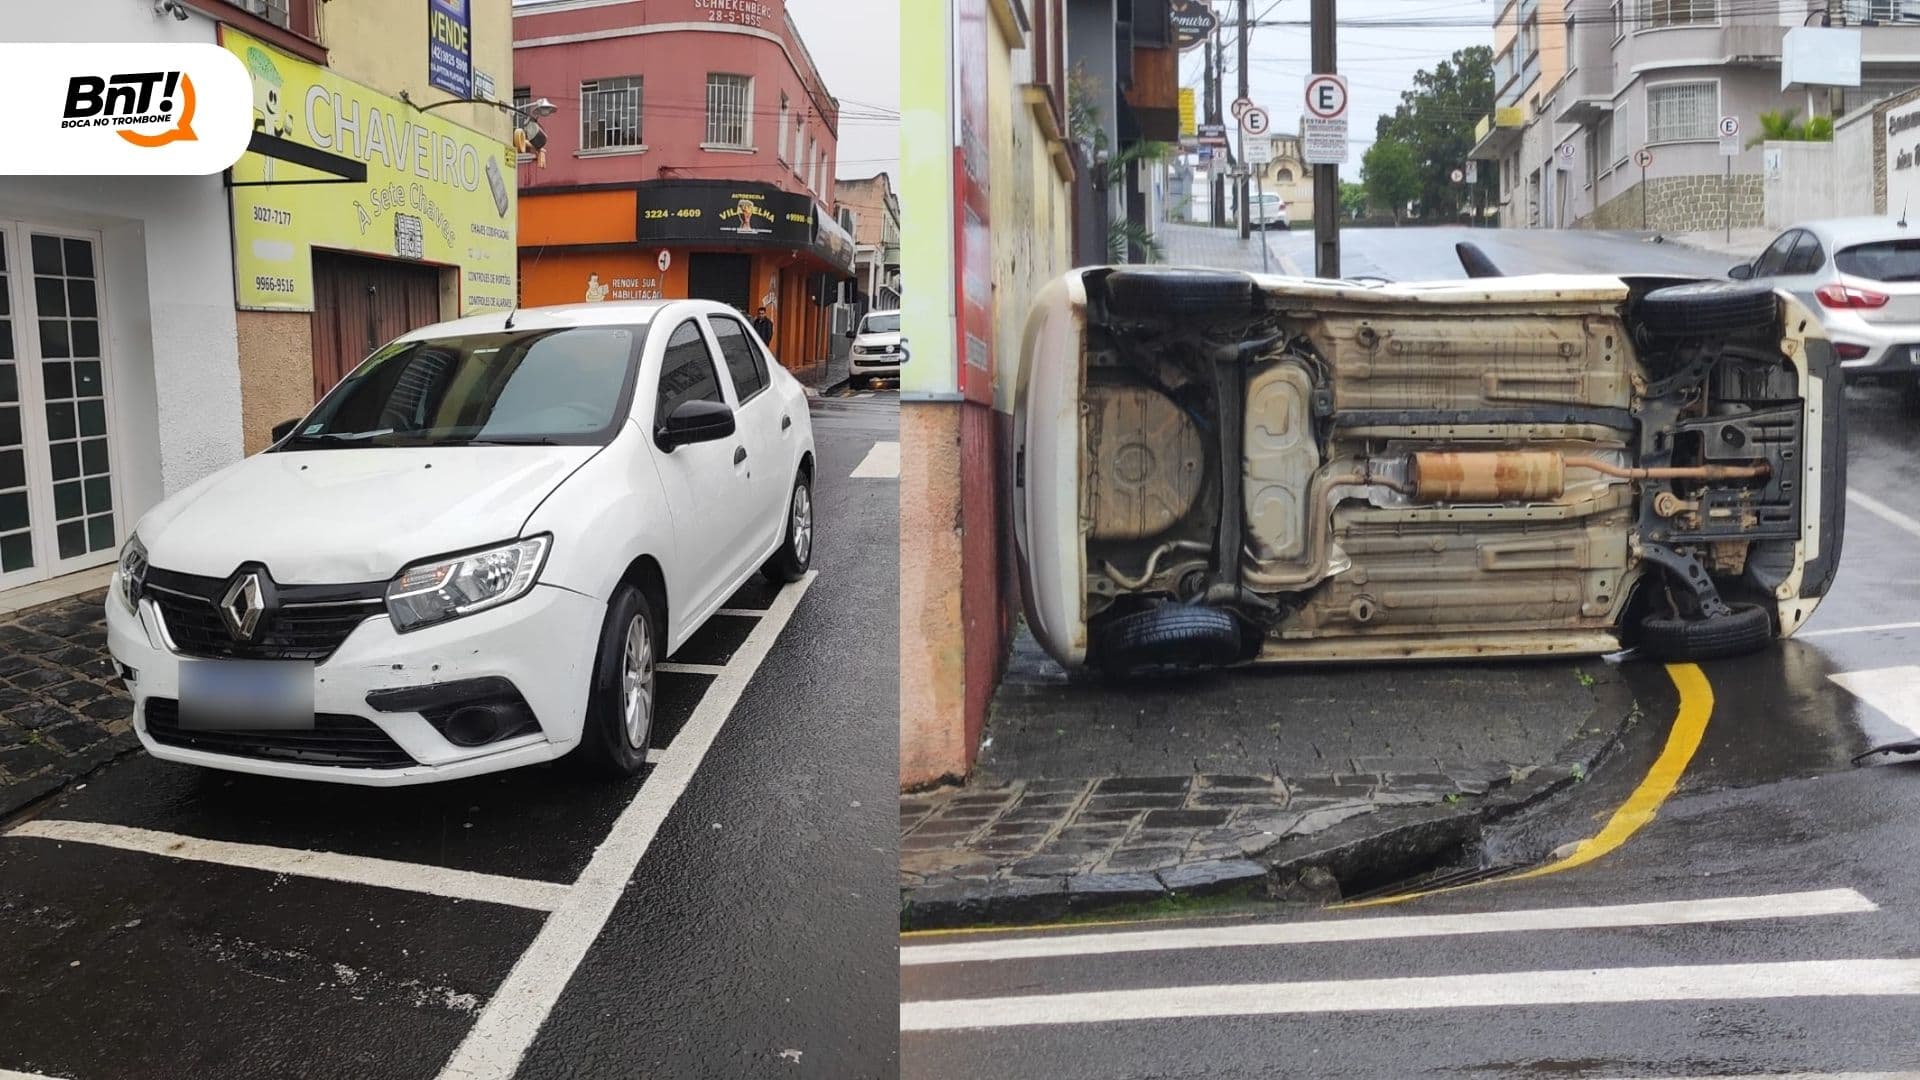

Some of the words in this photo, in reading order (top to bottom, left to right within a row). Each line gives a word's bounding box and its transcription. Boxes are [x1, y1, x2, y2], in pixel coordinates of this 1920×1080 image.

[431, 10, 468, 55] VENDE
[1319, 86, 1334, 109] E
[1250, 114, 1260, 129] E
[1726, 121, 1733, 132] E
[305, 84, 479, 192] CHAVEIRO
[253, 206, 291, 226] 3027-7177
[370, 181, 405, 217] Sete
[409, 183, 456, 248] Chaves
[644, 209, 668, 218] 3224
[677, 208, 701, 218] 4609
[719, 206, 742, 220] VILA
[255, 276, 295, 293] 9966-9516
[612, 279, 639, 288] RENOVE
[642, 278, 656, 288] SUA
